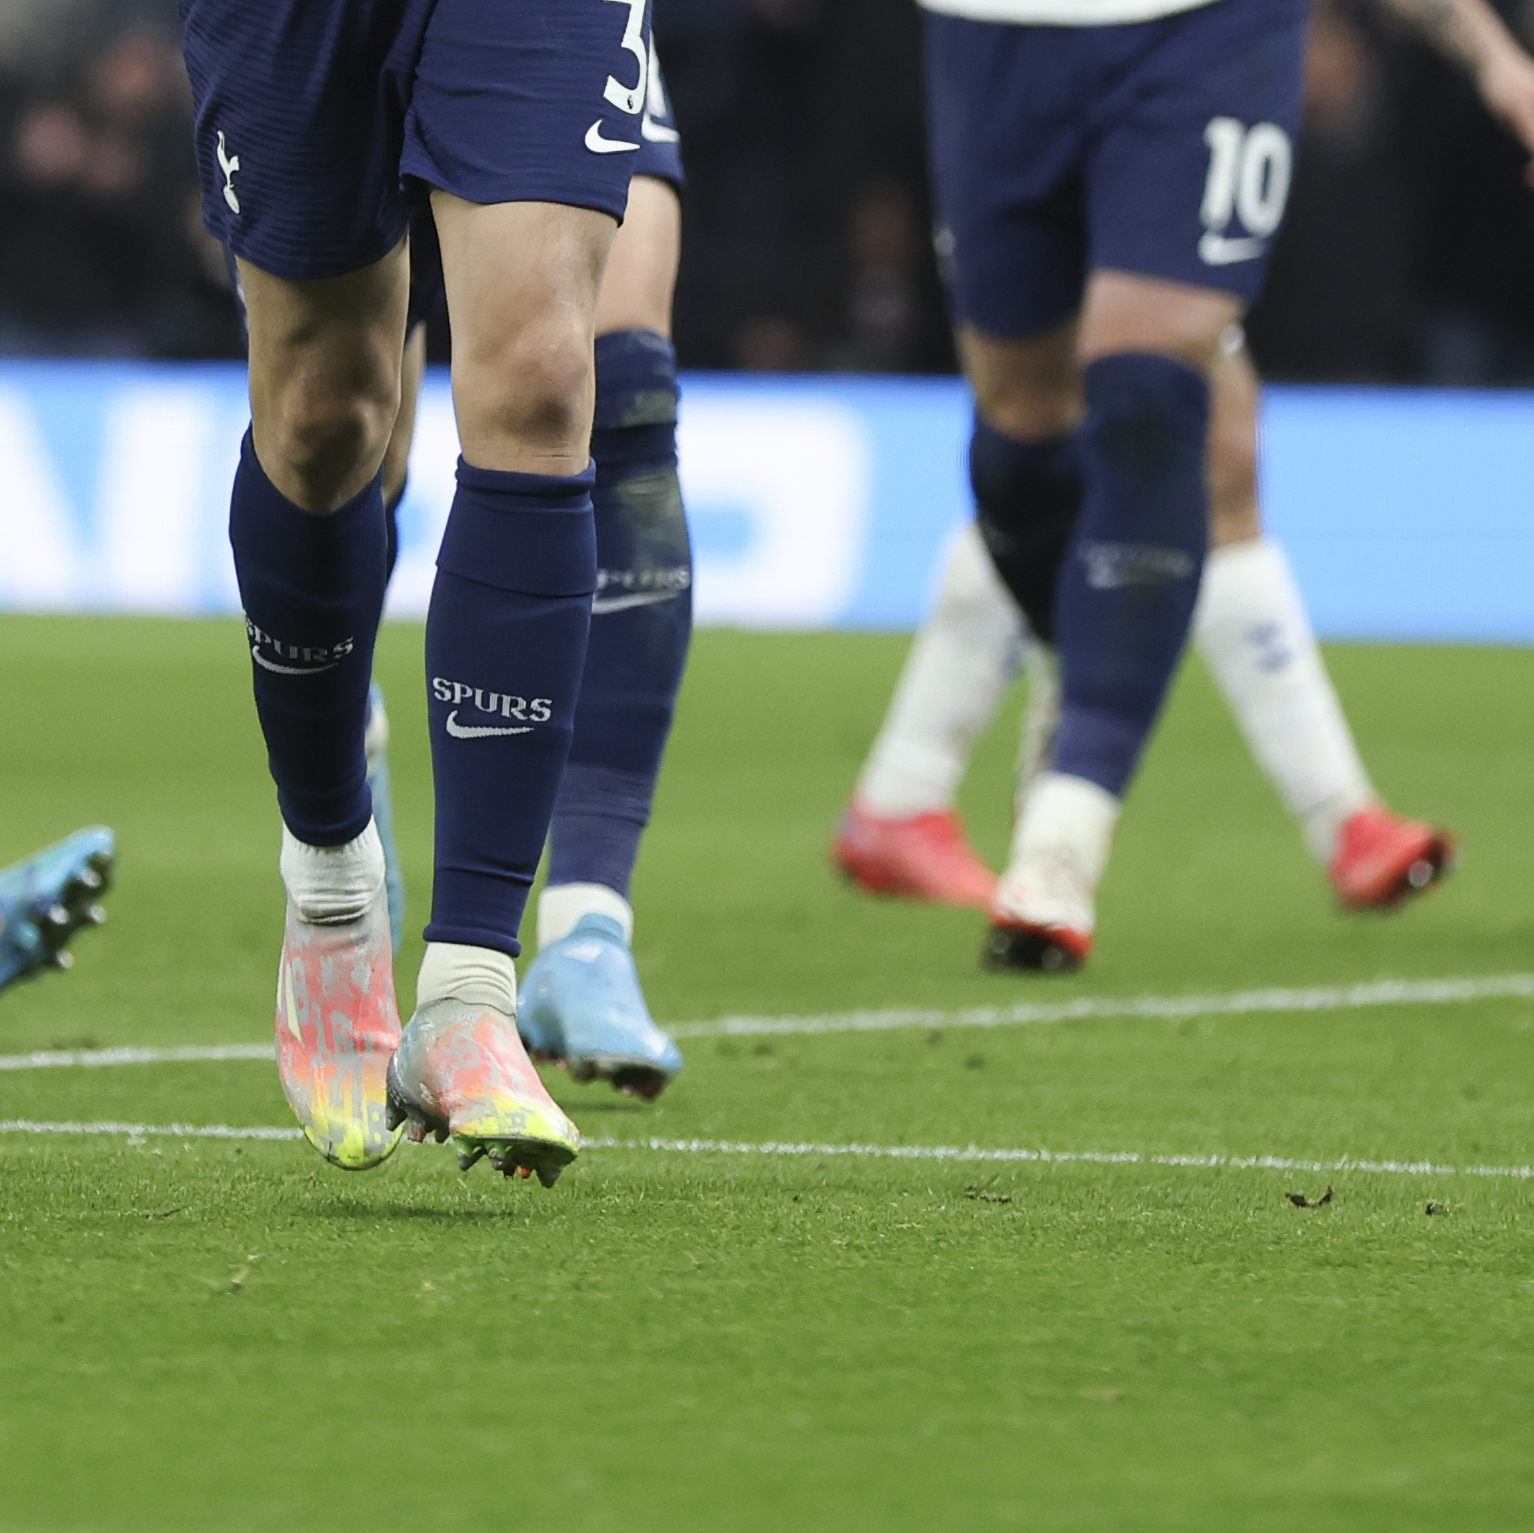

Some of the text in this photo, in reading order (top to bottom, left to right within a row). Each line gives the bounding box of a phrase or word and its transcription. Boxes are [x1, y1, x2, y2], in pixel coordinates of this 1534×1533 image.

[1199, 116, 1293, 238] 10
[242, 609, 354, 662] SPURS
[433, 676, 553, 723] SPURS
